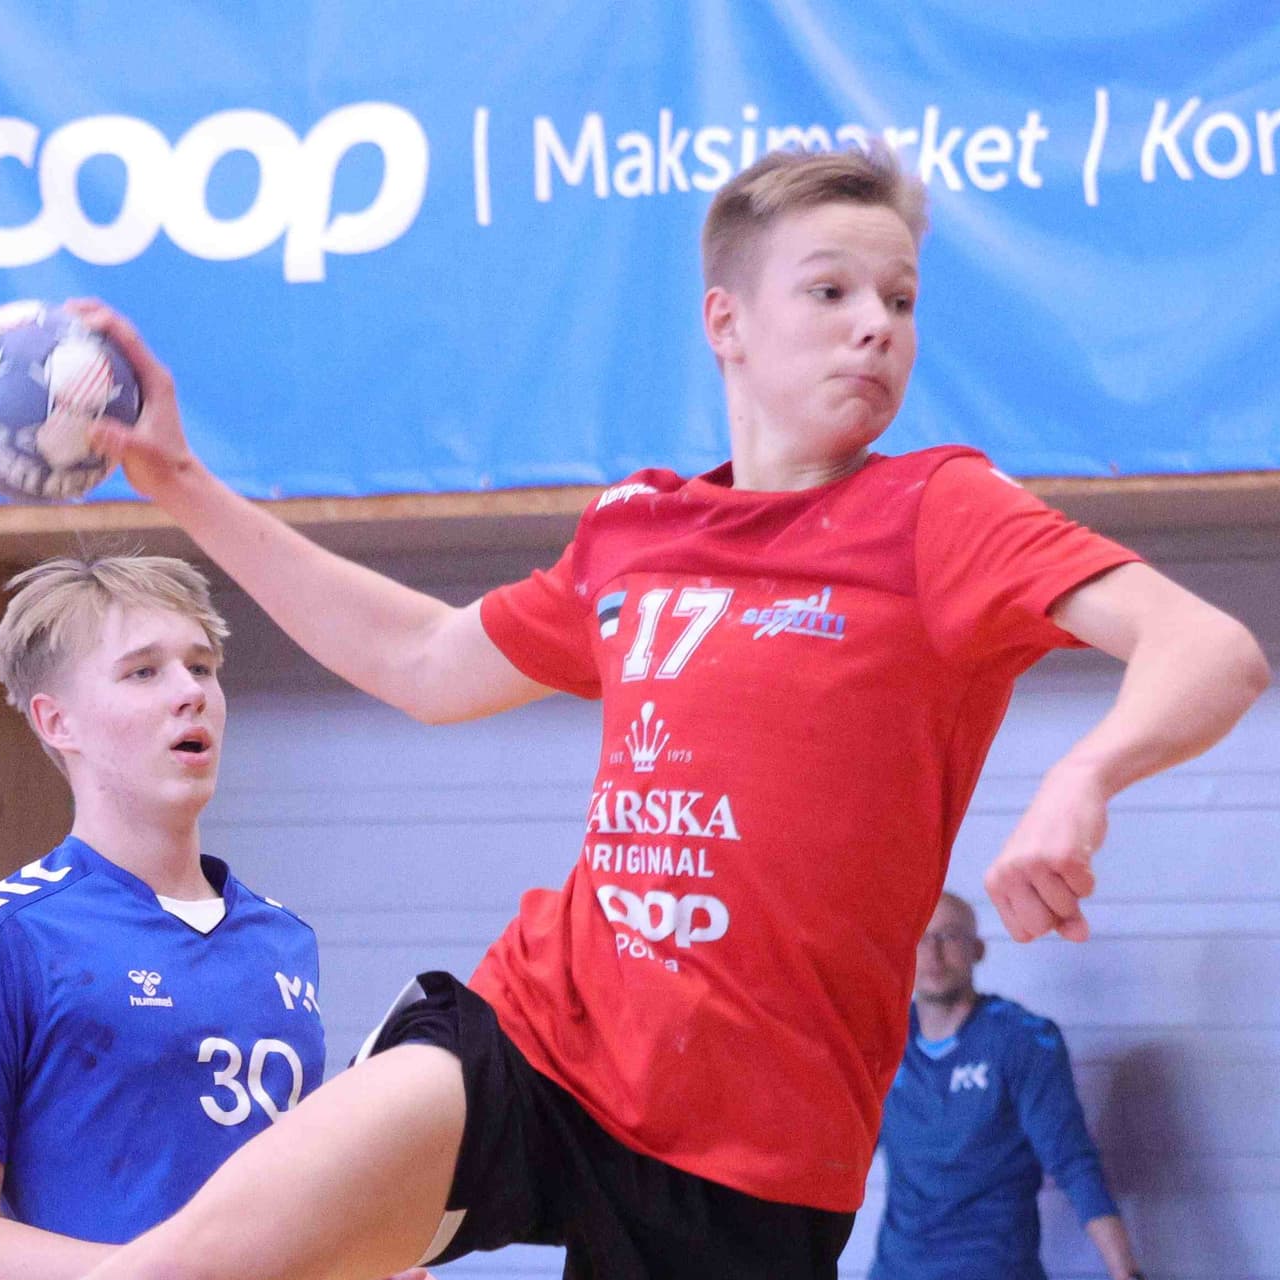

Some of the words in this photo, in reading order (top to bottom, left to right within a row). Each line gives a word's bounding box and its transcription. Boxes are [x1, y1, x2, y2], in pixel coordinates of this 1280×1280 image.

[621, 588, 736, 683] 17
[586, 780, 742, 841] ÄRSKA
[584, 843, 715, 878] RIGINAAL
[197, 1037, 304, 1126] 30
